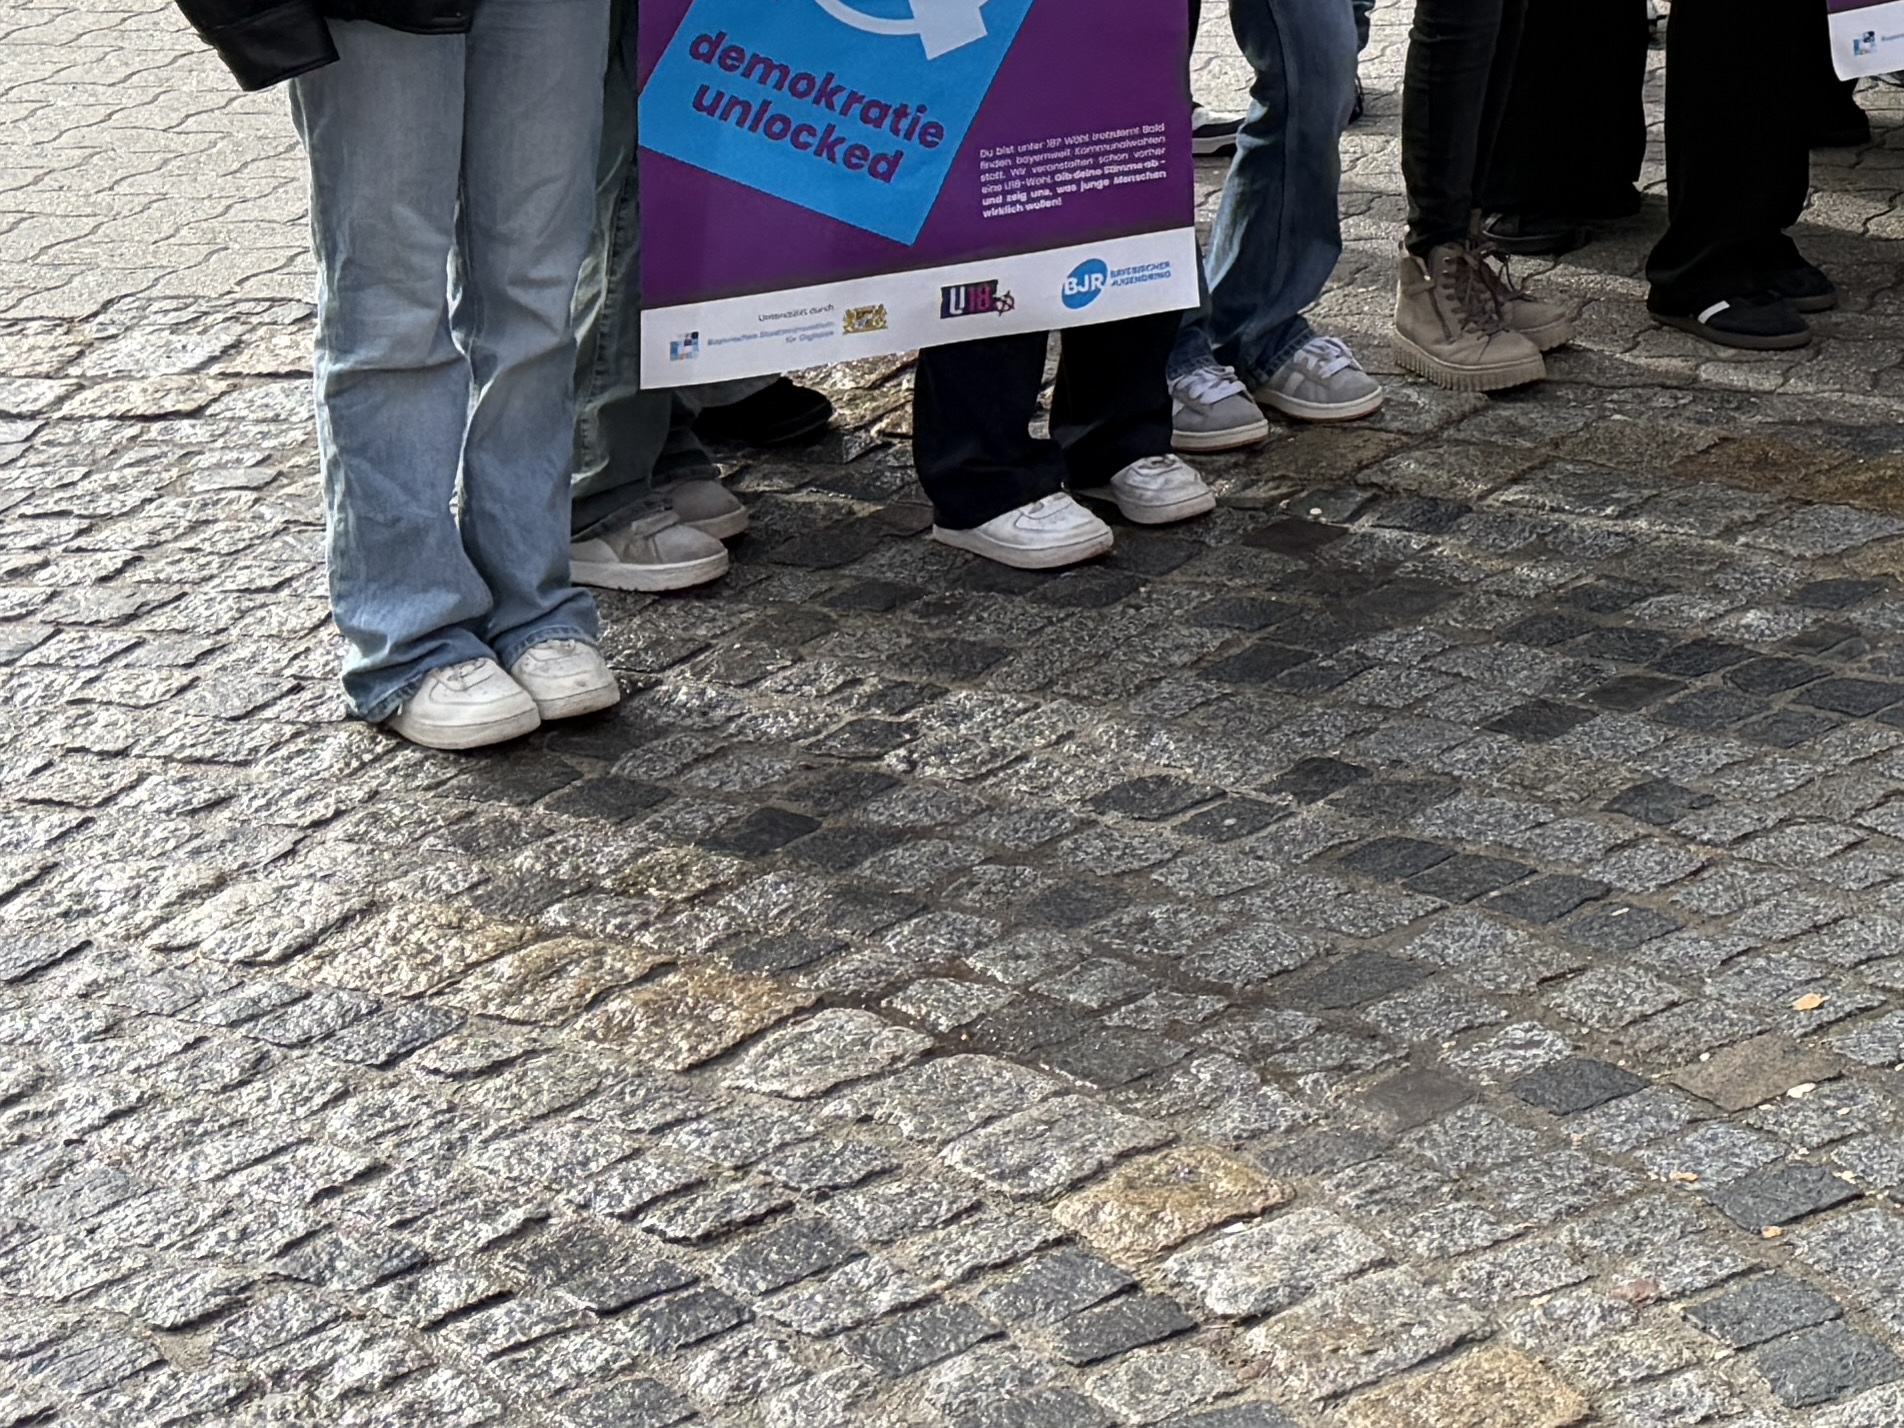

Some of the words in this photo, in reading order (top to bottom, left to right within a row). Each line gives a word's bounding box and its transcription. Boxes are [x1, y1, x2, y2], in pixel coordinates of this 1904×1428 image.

[689, 29, 944, 149] demokratie
[692, 81, 904, 183] unlocked
[980, 149, 993, 158] Du
[982, 197, 1002, 205] und
[1057, 184, 1077, 194] was
[1063, 273, 1104, 295] BJR
[950, 284, 992, 315] U18
